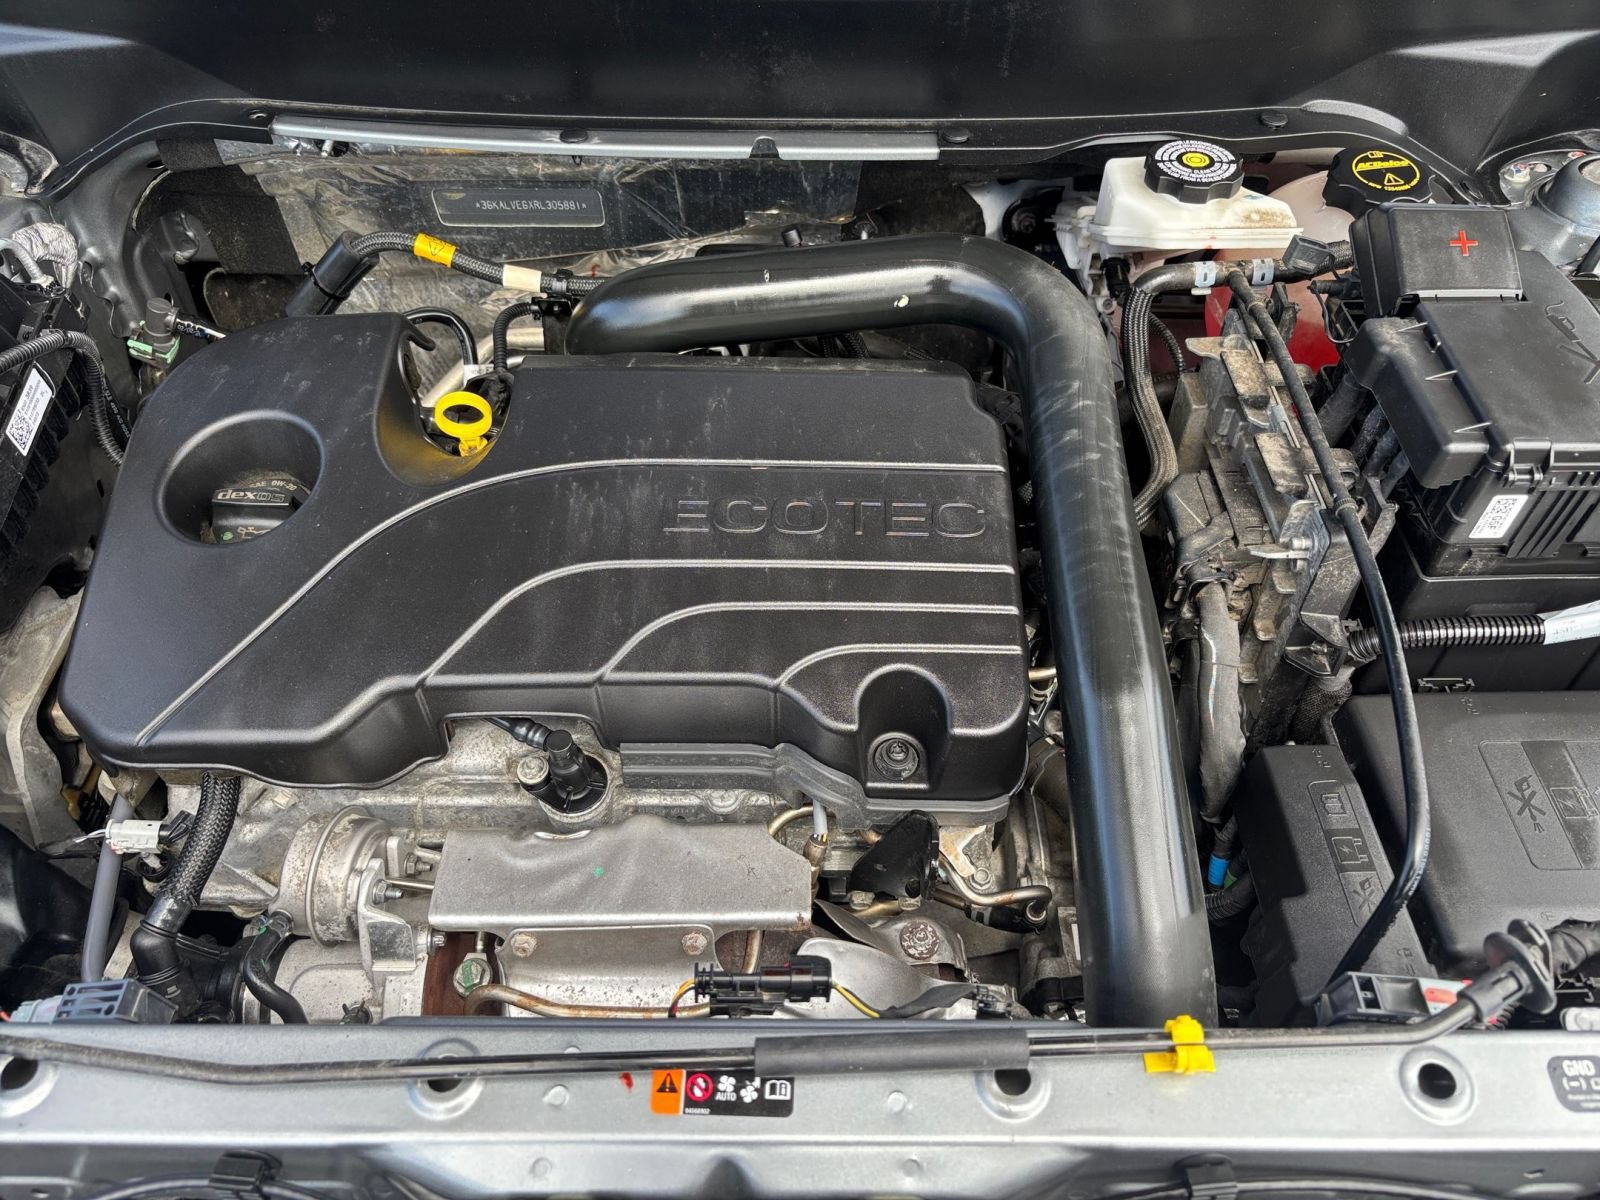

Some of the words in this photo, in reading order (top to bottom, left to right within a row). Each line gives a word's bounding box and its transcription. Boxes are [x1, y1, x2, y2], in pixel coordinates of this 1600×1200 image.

[1355, 160, 1409, 169] ACDelco
[217, 489, 285, 502] dexos
[662, 497, 987, 539] ECOTEC
[1562, 1059, 1596, 1077] GND
[715, 1091, 737, 1101] AUTO
